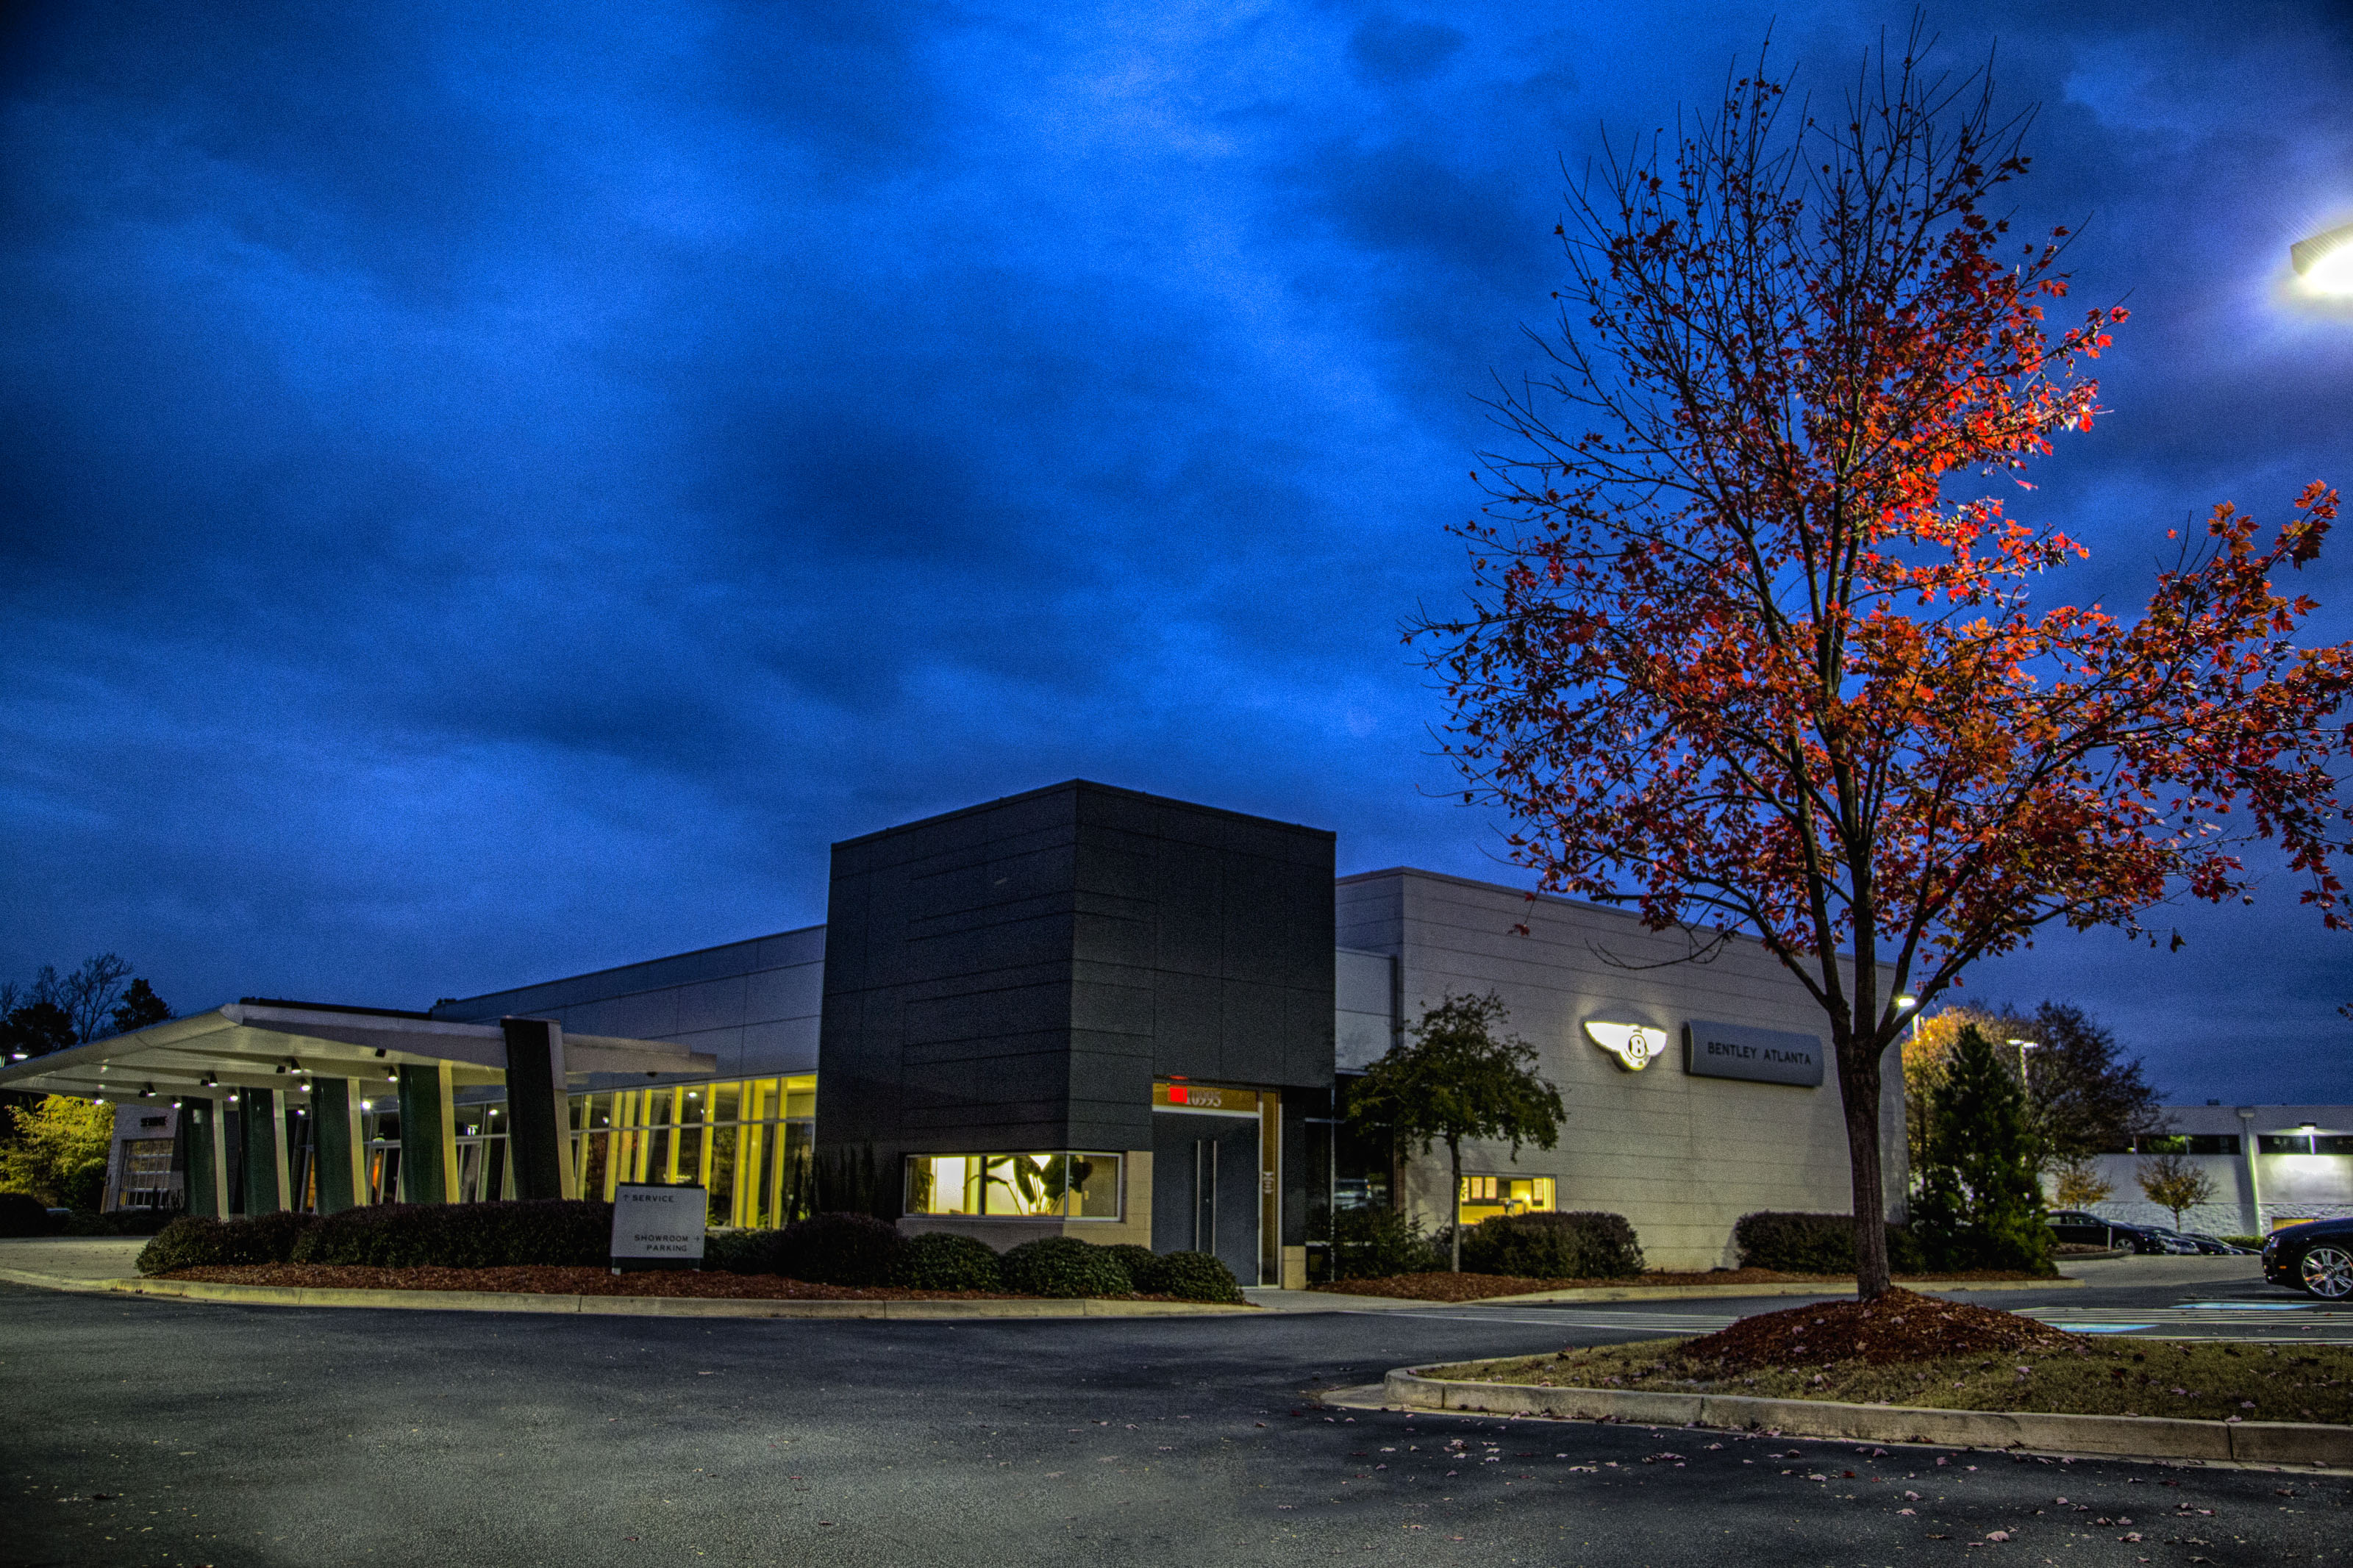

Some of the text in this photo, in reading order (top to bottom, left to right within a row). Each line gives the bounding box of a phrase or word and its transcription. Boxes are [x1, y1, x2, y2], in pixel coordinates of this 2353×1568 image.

[1707, 1042, 1812, 1064] BENTLEY ATLANTA
[632, 1194, 674, 1203] SERVICE
[634, 1234, 688, 1242] SHOWROOM
